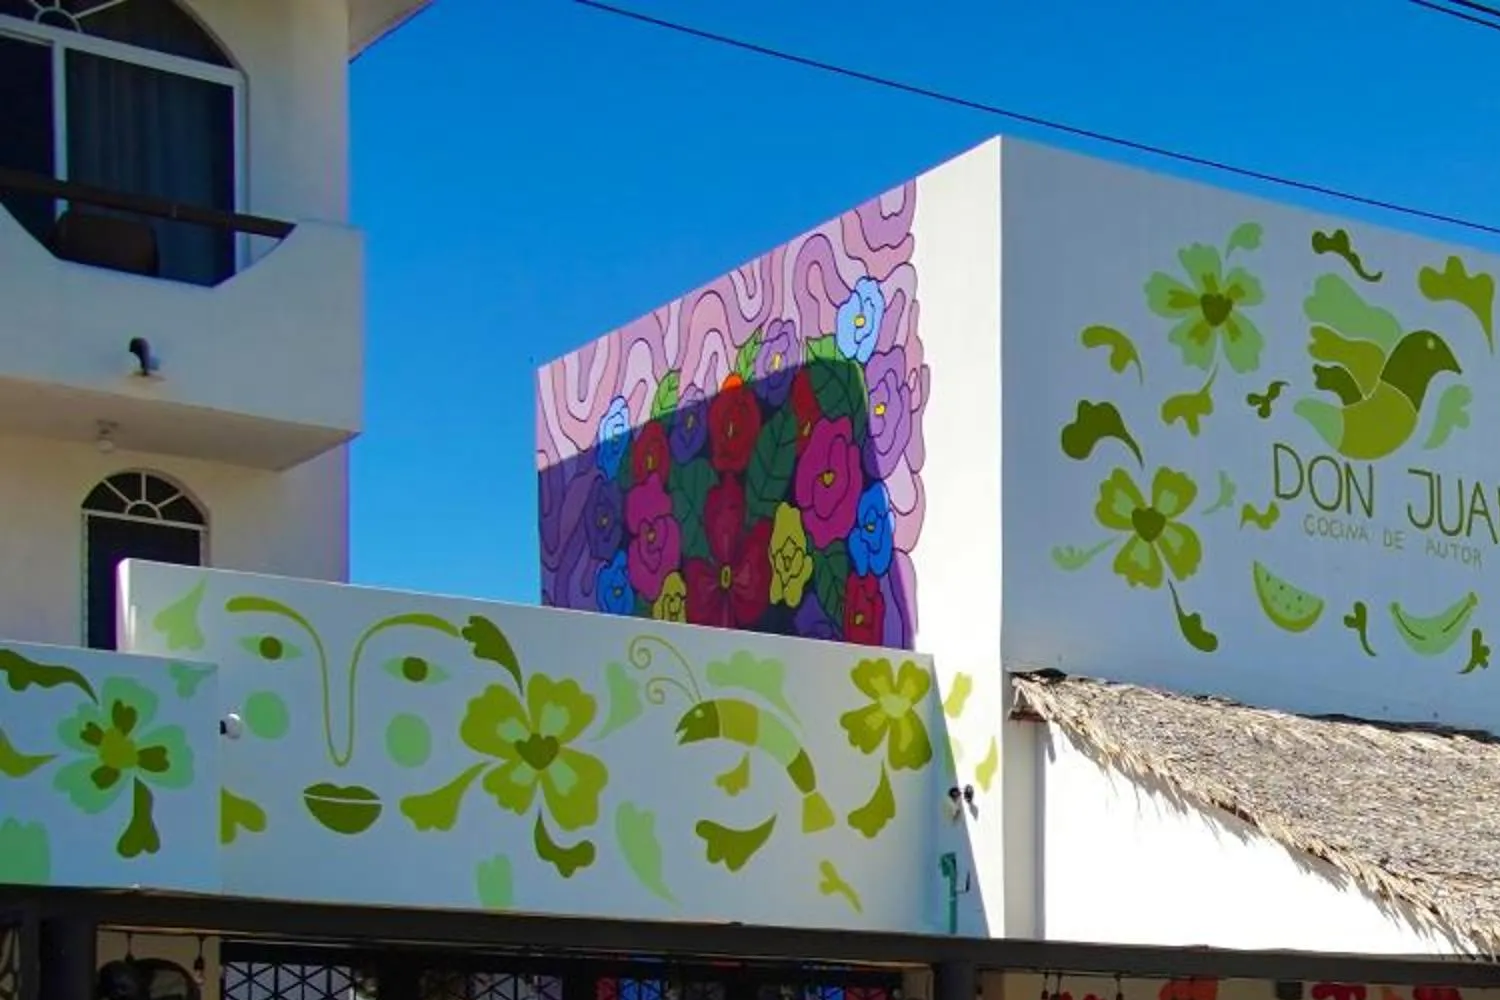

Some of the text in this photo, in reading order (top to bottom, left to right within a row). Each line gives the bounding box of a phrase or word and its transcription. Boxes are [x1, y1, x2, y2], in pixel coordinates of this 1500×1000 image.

[1273, 443, 1373, 518] DON
[1303, 514, 1482, 568] COCINA DE AUTOR
